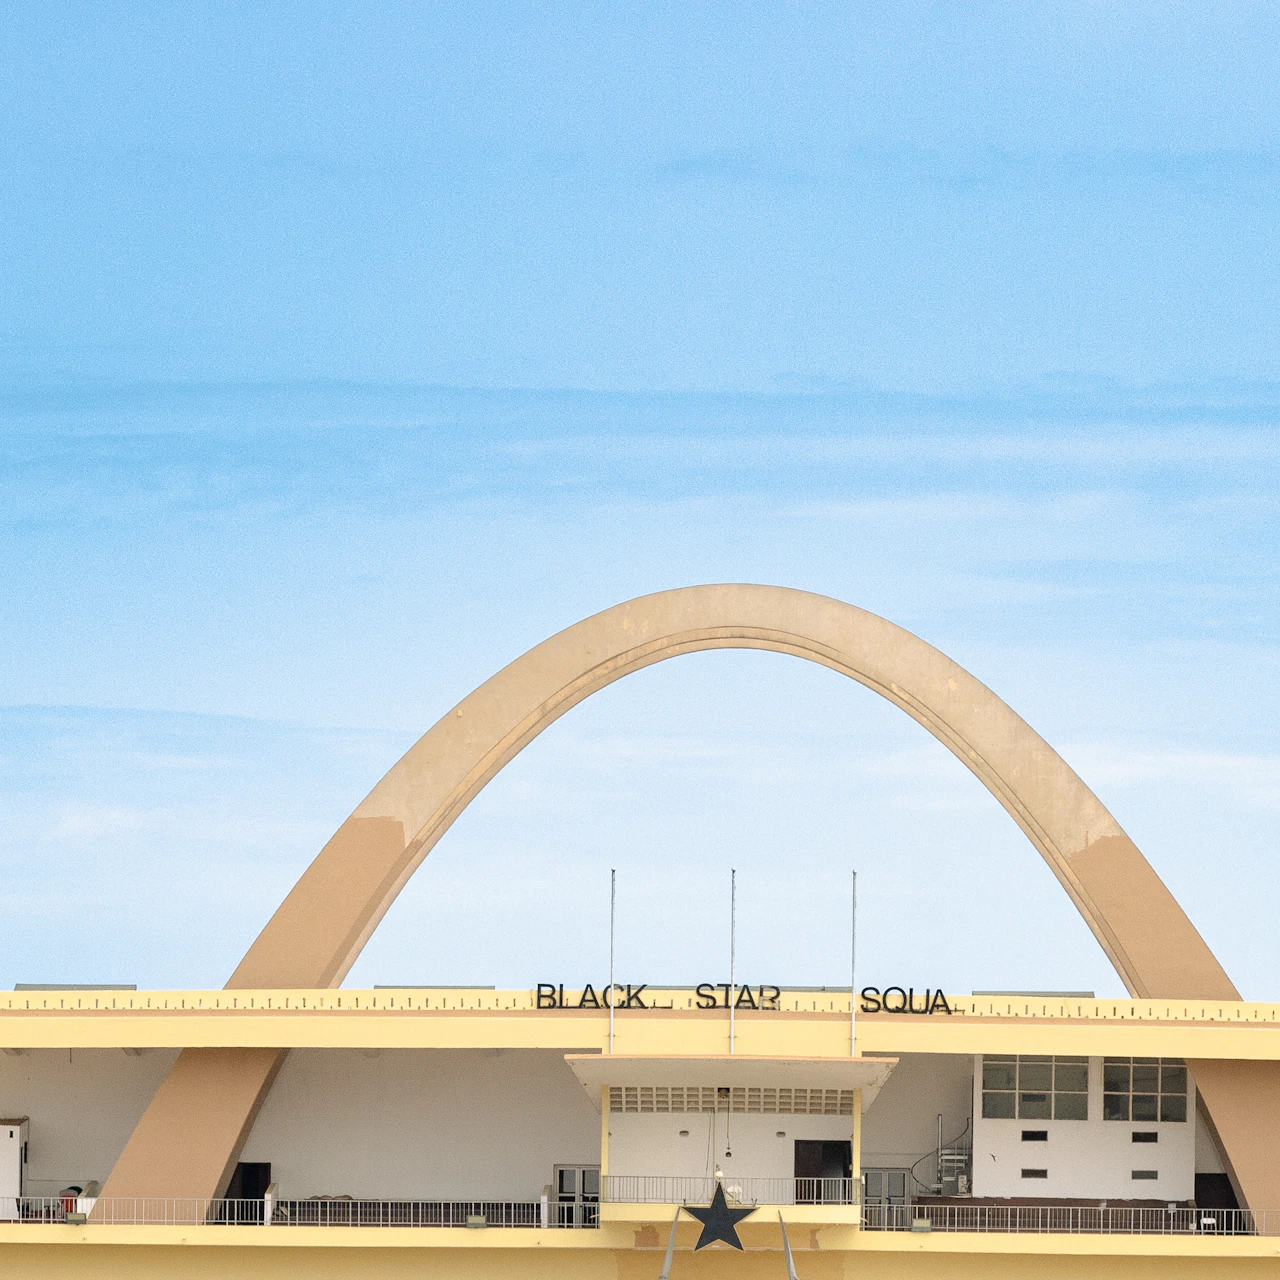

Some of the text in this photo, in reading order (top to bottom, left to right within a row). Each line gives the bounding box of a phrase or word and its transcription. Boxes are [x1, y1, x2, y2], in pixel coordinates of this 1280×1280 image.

[537, 983, 952, 1015] BLACK STAR SQUA
